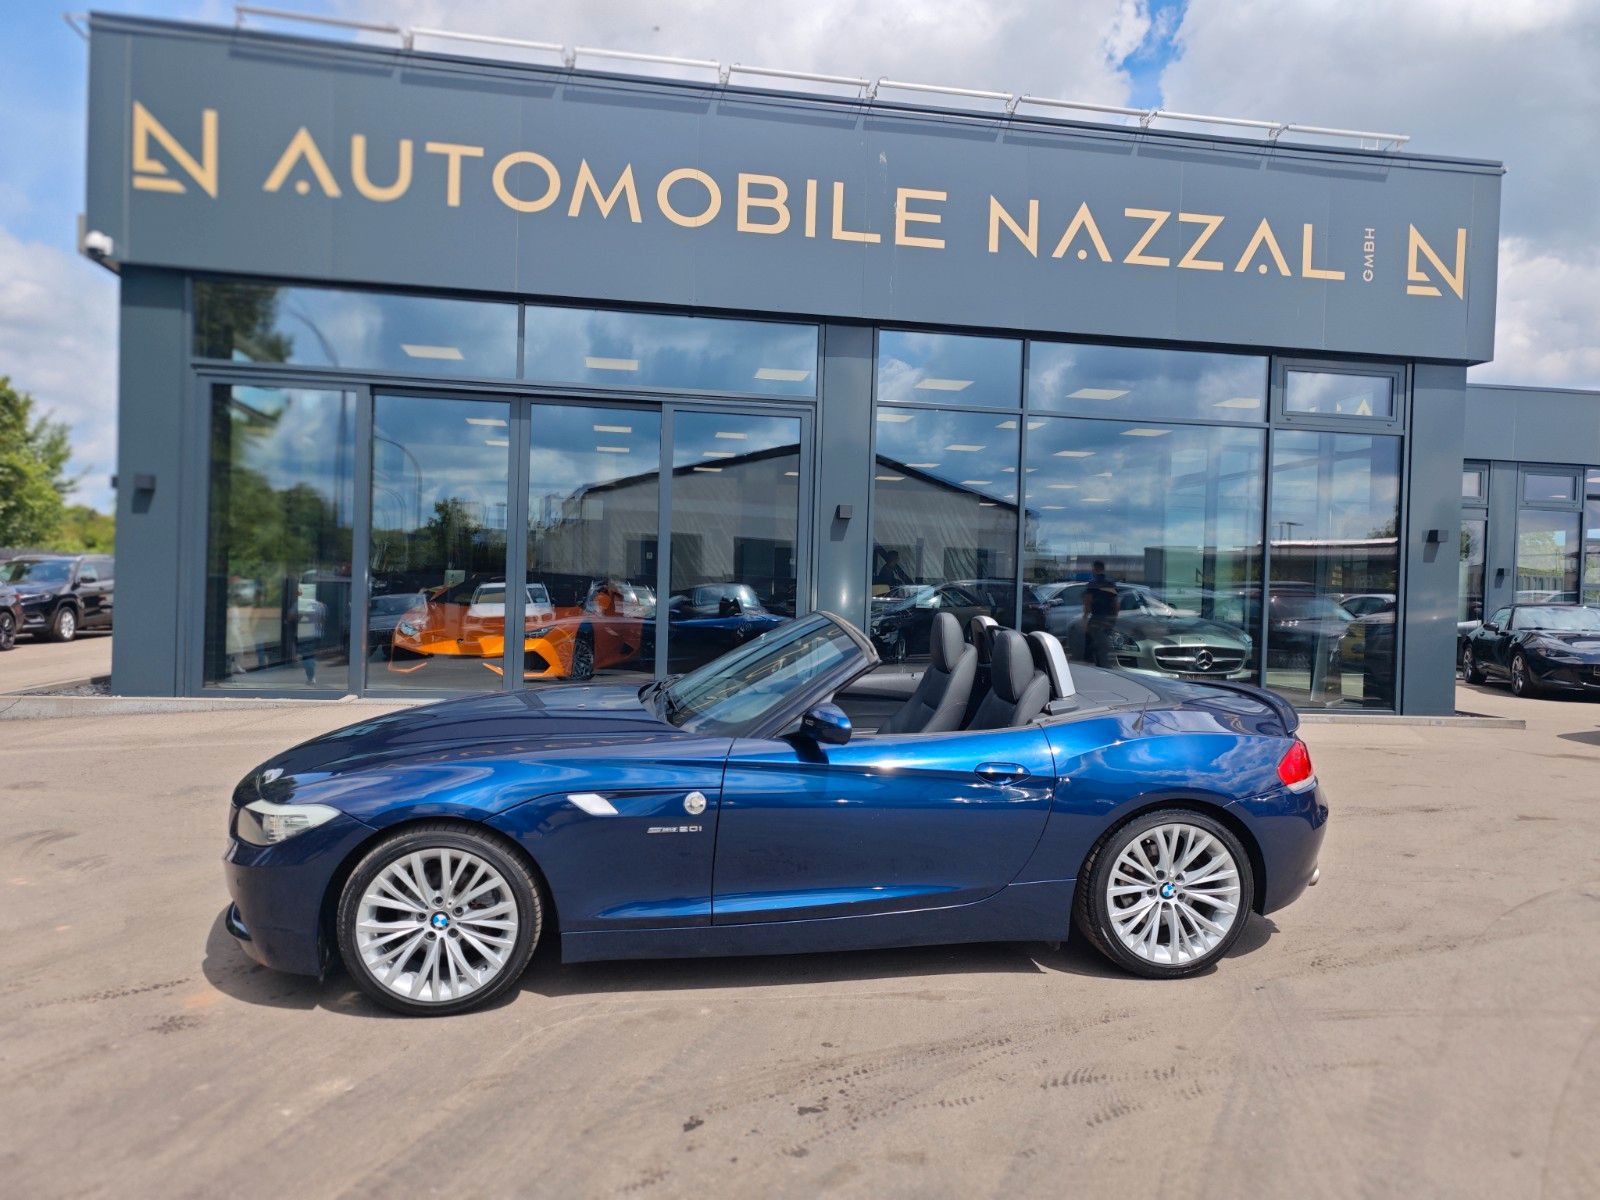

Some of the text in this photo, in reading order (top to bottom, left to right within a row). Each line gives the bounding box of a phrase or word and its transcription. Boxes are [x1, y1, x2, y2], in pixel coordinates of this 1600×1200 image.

[264, 128, 1345, 282] AUTOMOBILE NAZZAL
[1363, 227, 1376, 282] GMBH
